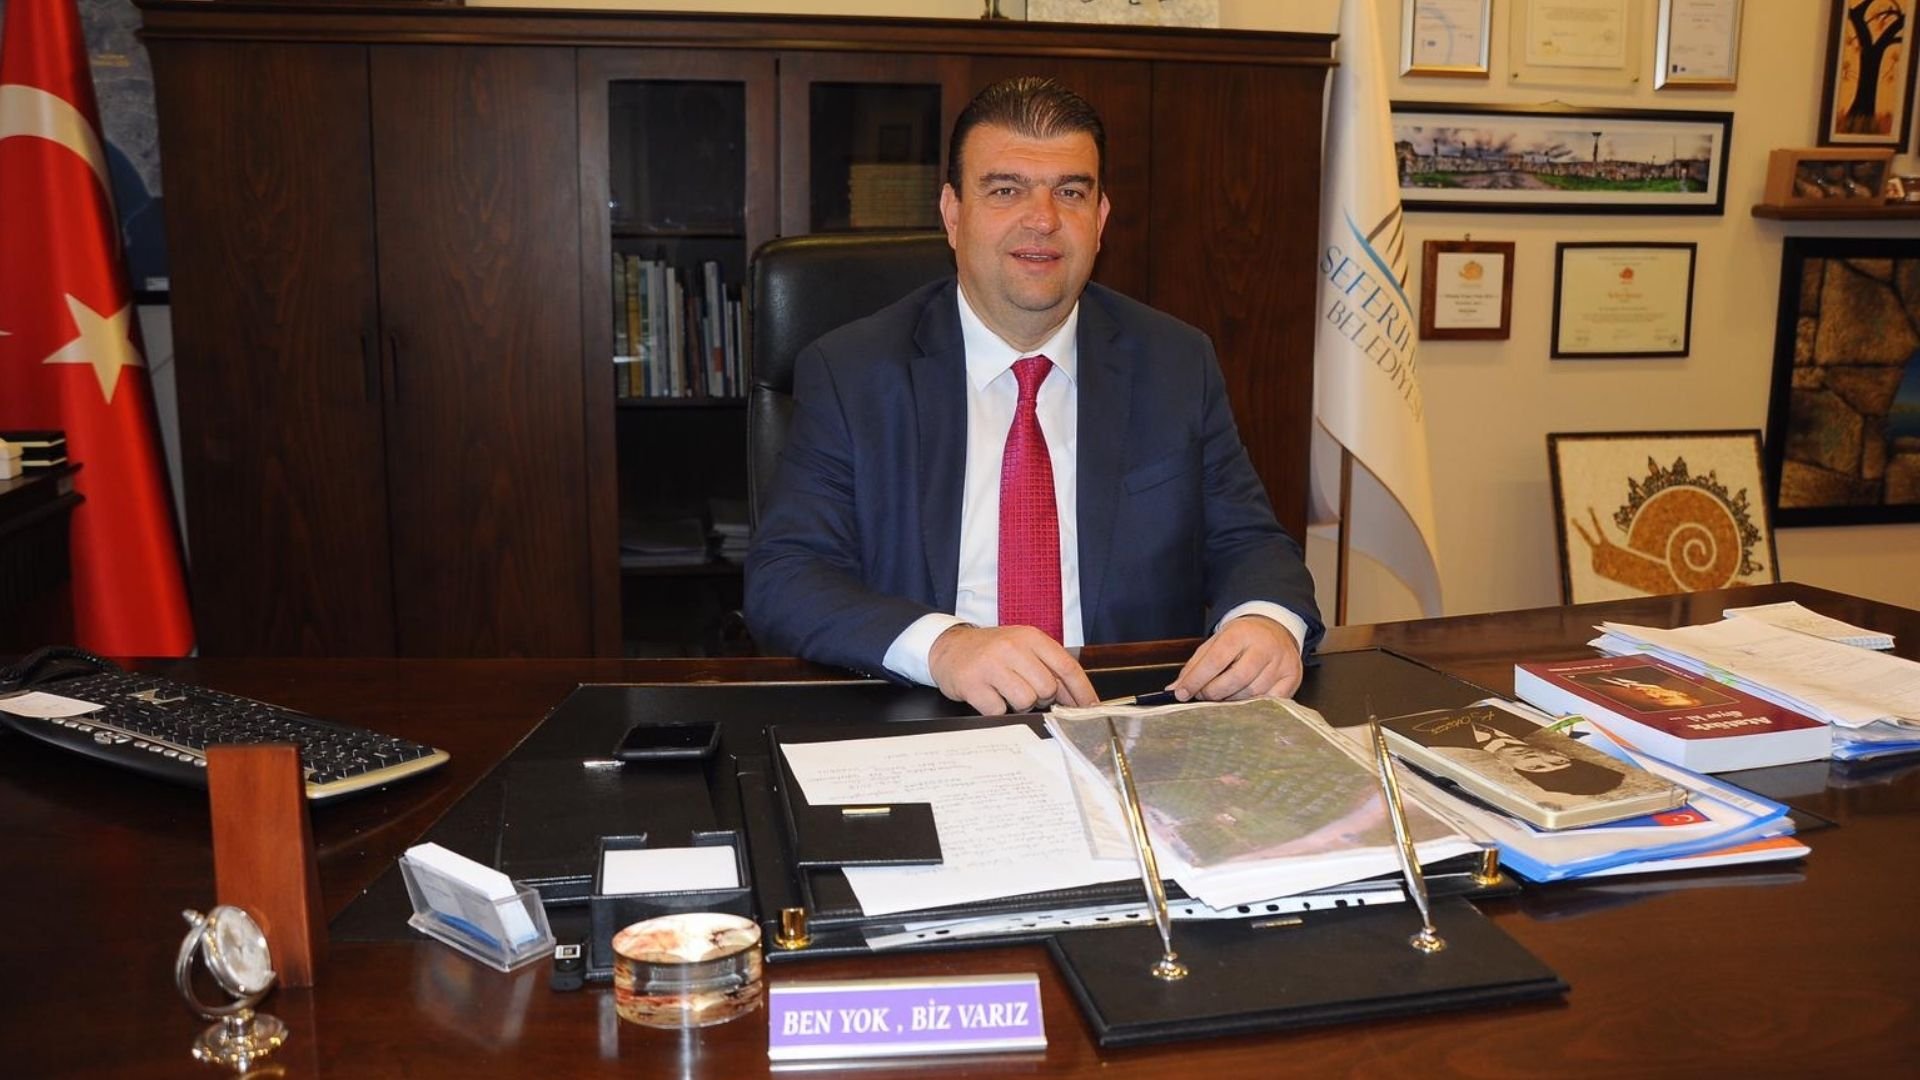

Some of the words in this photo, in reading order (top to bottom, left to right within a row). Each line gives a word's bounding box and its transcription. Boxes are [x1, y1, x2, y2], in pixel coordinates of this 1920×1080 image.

[782, 1009, 832, 1036] BEN
[838, 1007, 890, 1033] YOK
[911, 998, 952, 1031] BİZ
[957, 1001, 1029, 1028] VARIZ
